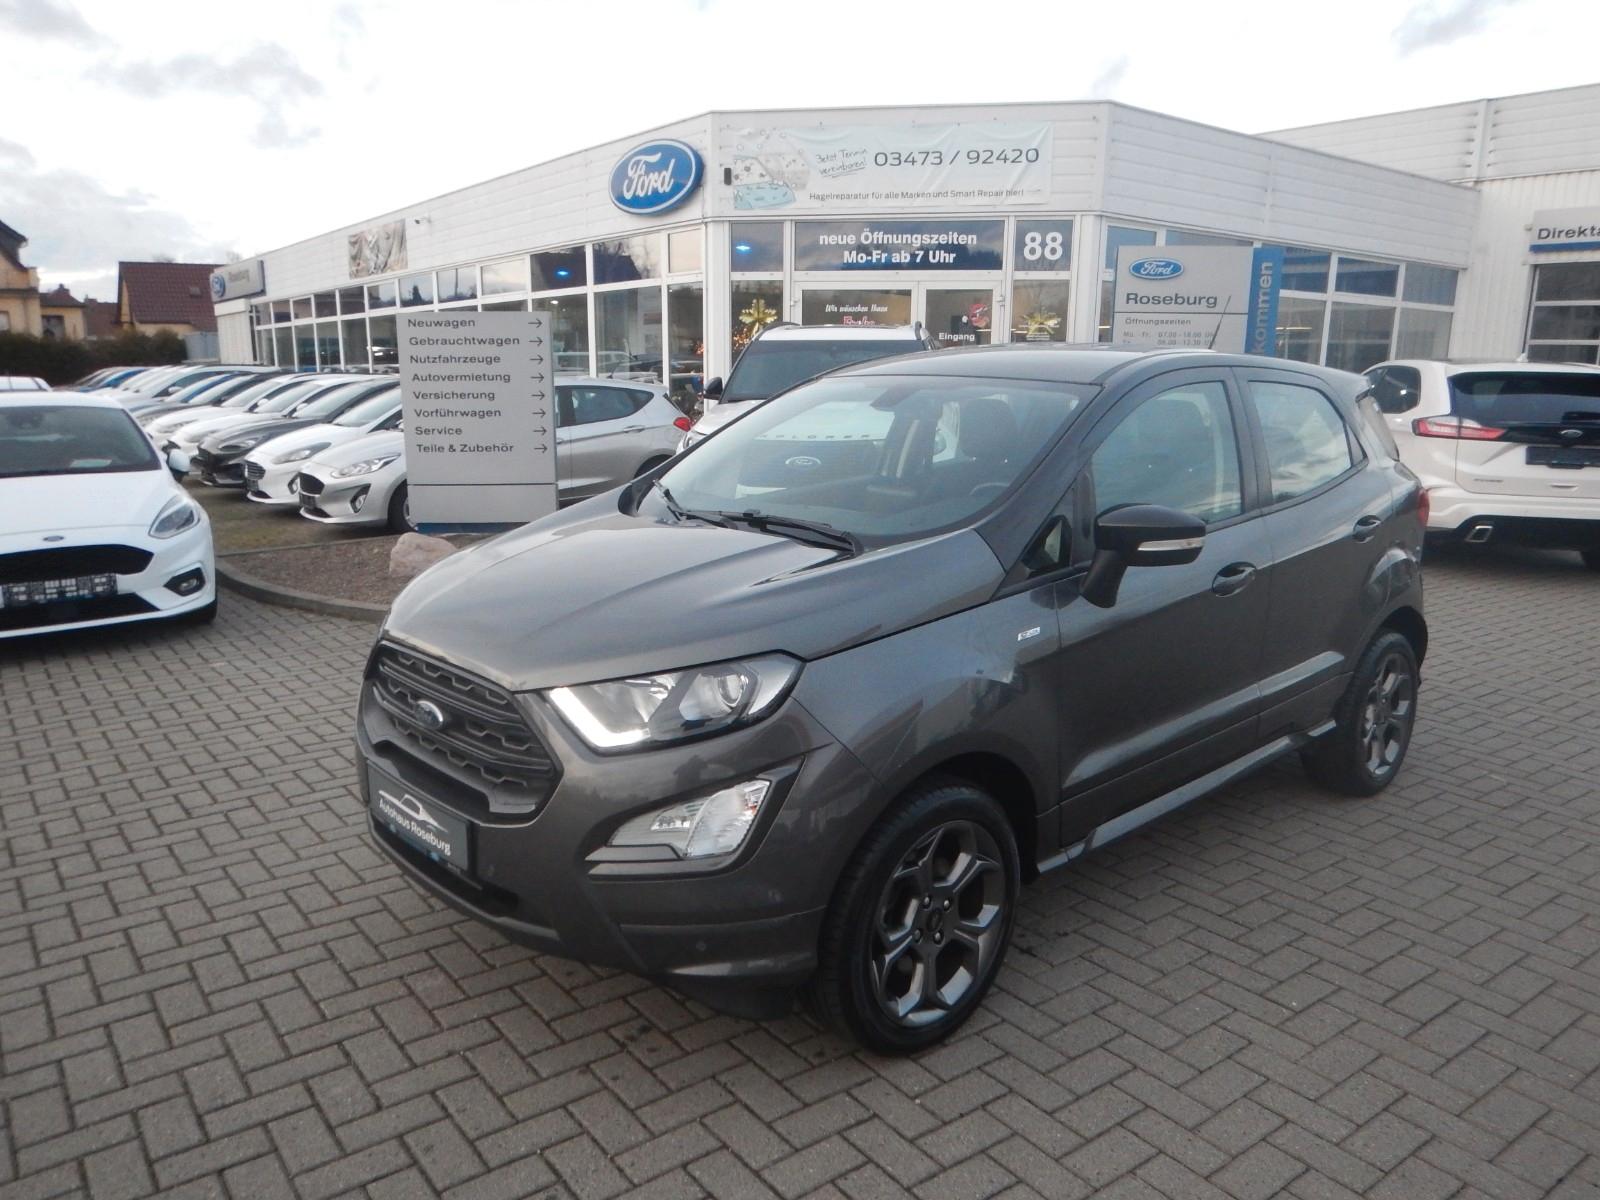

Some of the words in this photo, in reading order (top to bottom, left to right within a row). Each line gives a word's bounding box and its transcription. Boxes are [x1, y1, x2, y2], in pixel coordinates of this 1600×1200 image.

[874, 150, 943, 167] 03473
[949, 150, 961, 166] /
[966, 148, 1040, 165] 92420
[623, 152, 676, 200] Ford
[809, 191, 870, 201] Hagelreparatur
[871, 191, 883, 200] für
[884, 191, 900, 200] alle
[932, 190, 949, 198] und
[950, 189, 976, 198] Smart
[819, 233, 857, 245] neue
[860, 228, 978, 248] Öffnungszeiten
[1023, 231, 1063, 261] 88
[843, 250, 888, 264] Mo-Fr
[891, 250, 911, 264] ab
[915, 250, 925, 263] 7
[928, 250, 957, 264] Uhr
[1140, 261, 1175, 275] Ford
[1125, 292, 1218, 308] Roseburg
[407, 317, 476, 329] Neuwagen
[1124, 317, 1192, 326] Öffnungszeiten
[408, 336, 520, 347] Gebrauchtwagen
[938, 332, 976, 342] Eingang
[409, 355, 501, 366] Nutzfahrzeuge
[411, 373, 511, 384] Autovermietung
[412, 391, 496, 402] Versicherung
[414, 408, 502, 419] Vorführwagen
[415, 426, 463, 436] Service
[416, 444, 445, 453] Teile
[448, 444, 457, 453] &
[460, 442, 514, 453] Zubehör
[379, 797, 410, 830] Autohaus
[410, 820, 452, 857] Roseburg
